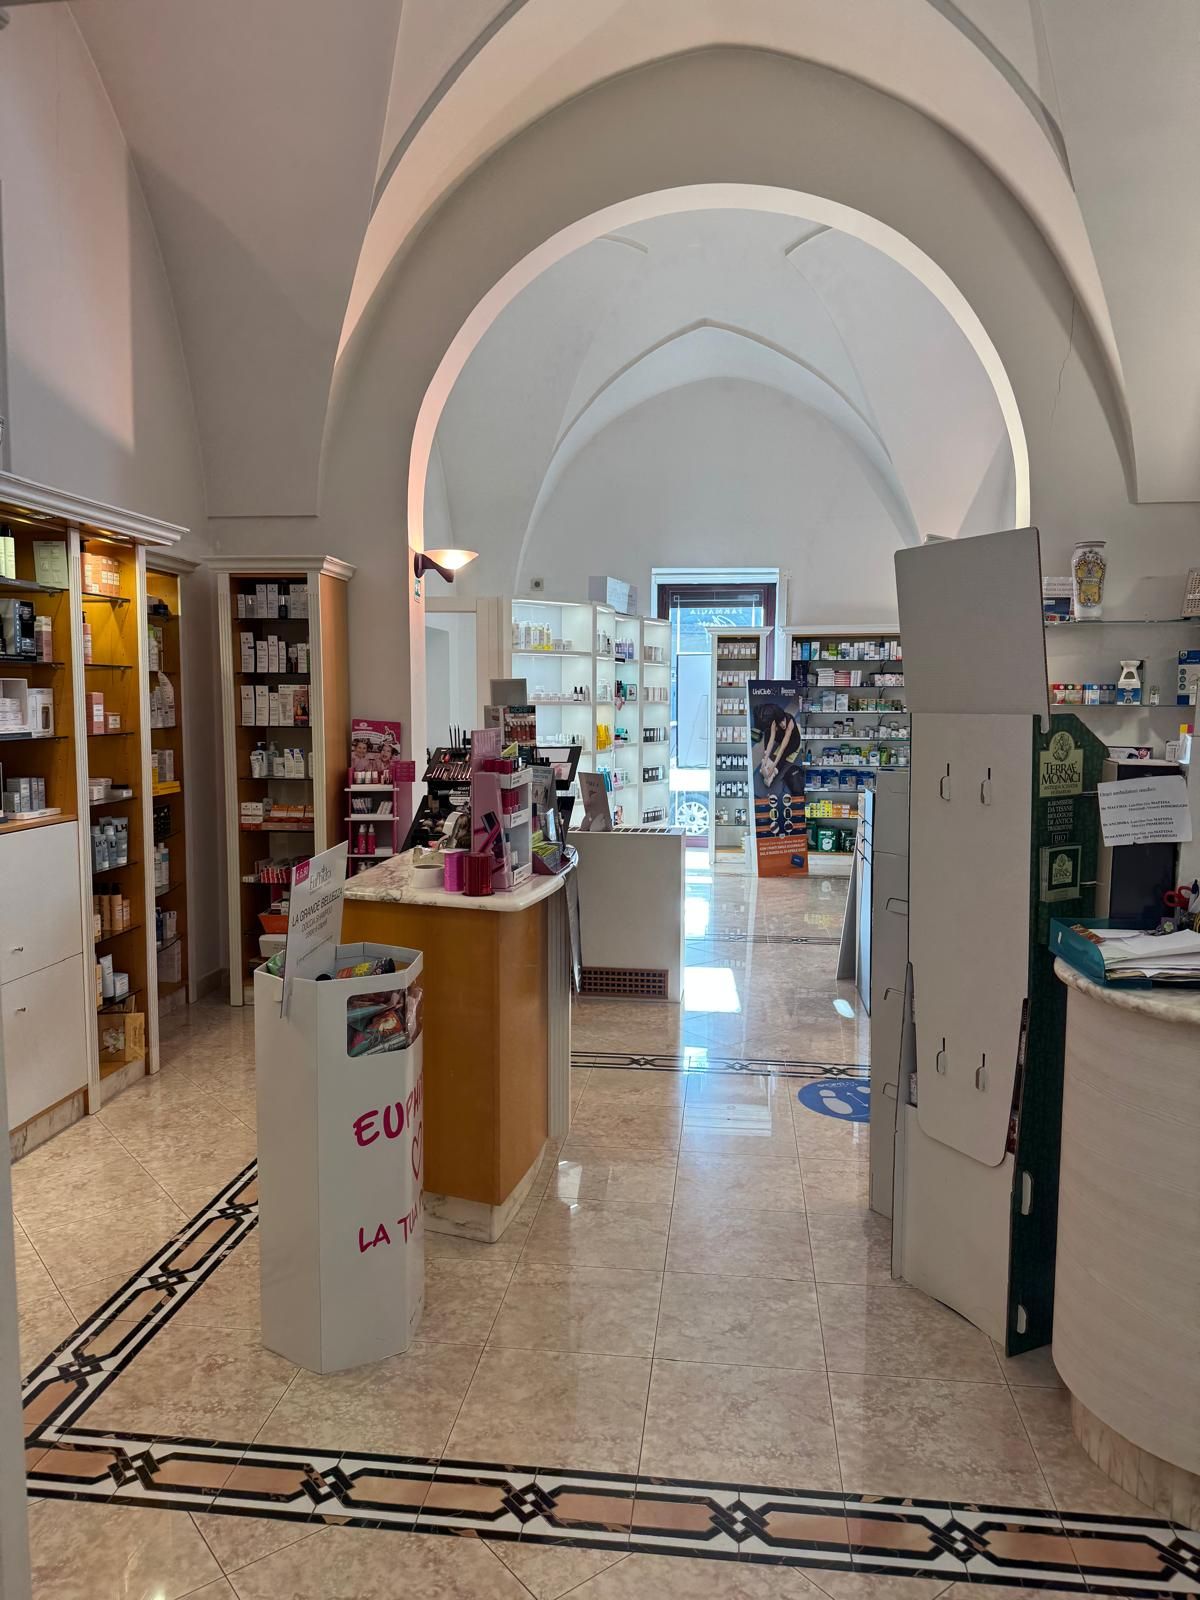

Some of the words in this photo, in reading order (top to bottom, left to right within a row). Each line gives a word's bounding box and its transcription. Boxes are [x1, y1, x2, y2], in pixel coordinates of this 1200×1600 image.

[1041, 773, 1081, 785] MONACI
[292, 914, 299, 927] LA
[299, 900, 320, 922] GRANDE
[320, 887, 344, 909] BELLEZZA
[359, 1222, 391, 1252] LA
